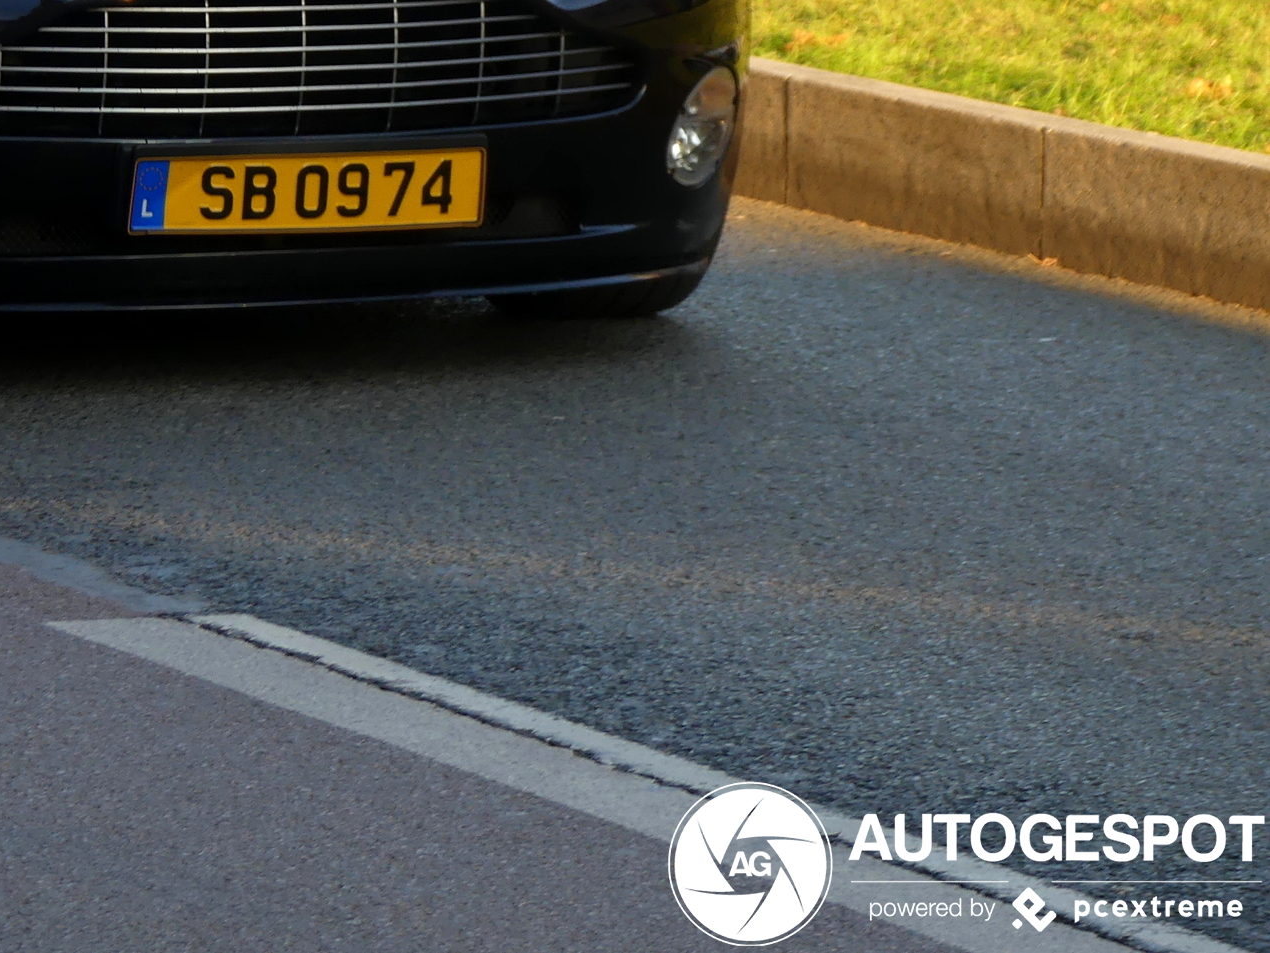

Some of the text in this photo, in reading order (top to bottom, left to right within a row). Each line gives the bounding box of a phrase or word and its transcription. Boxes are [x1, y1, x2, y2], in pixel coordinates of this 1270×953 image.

[140, 198, 154, 218] L
[199, 158, 454, 221] SB 0974
